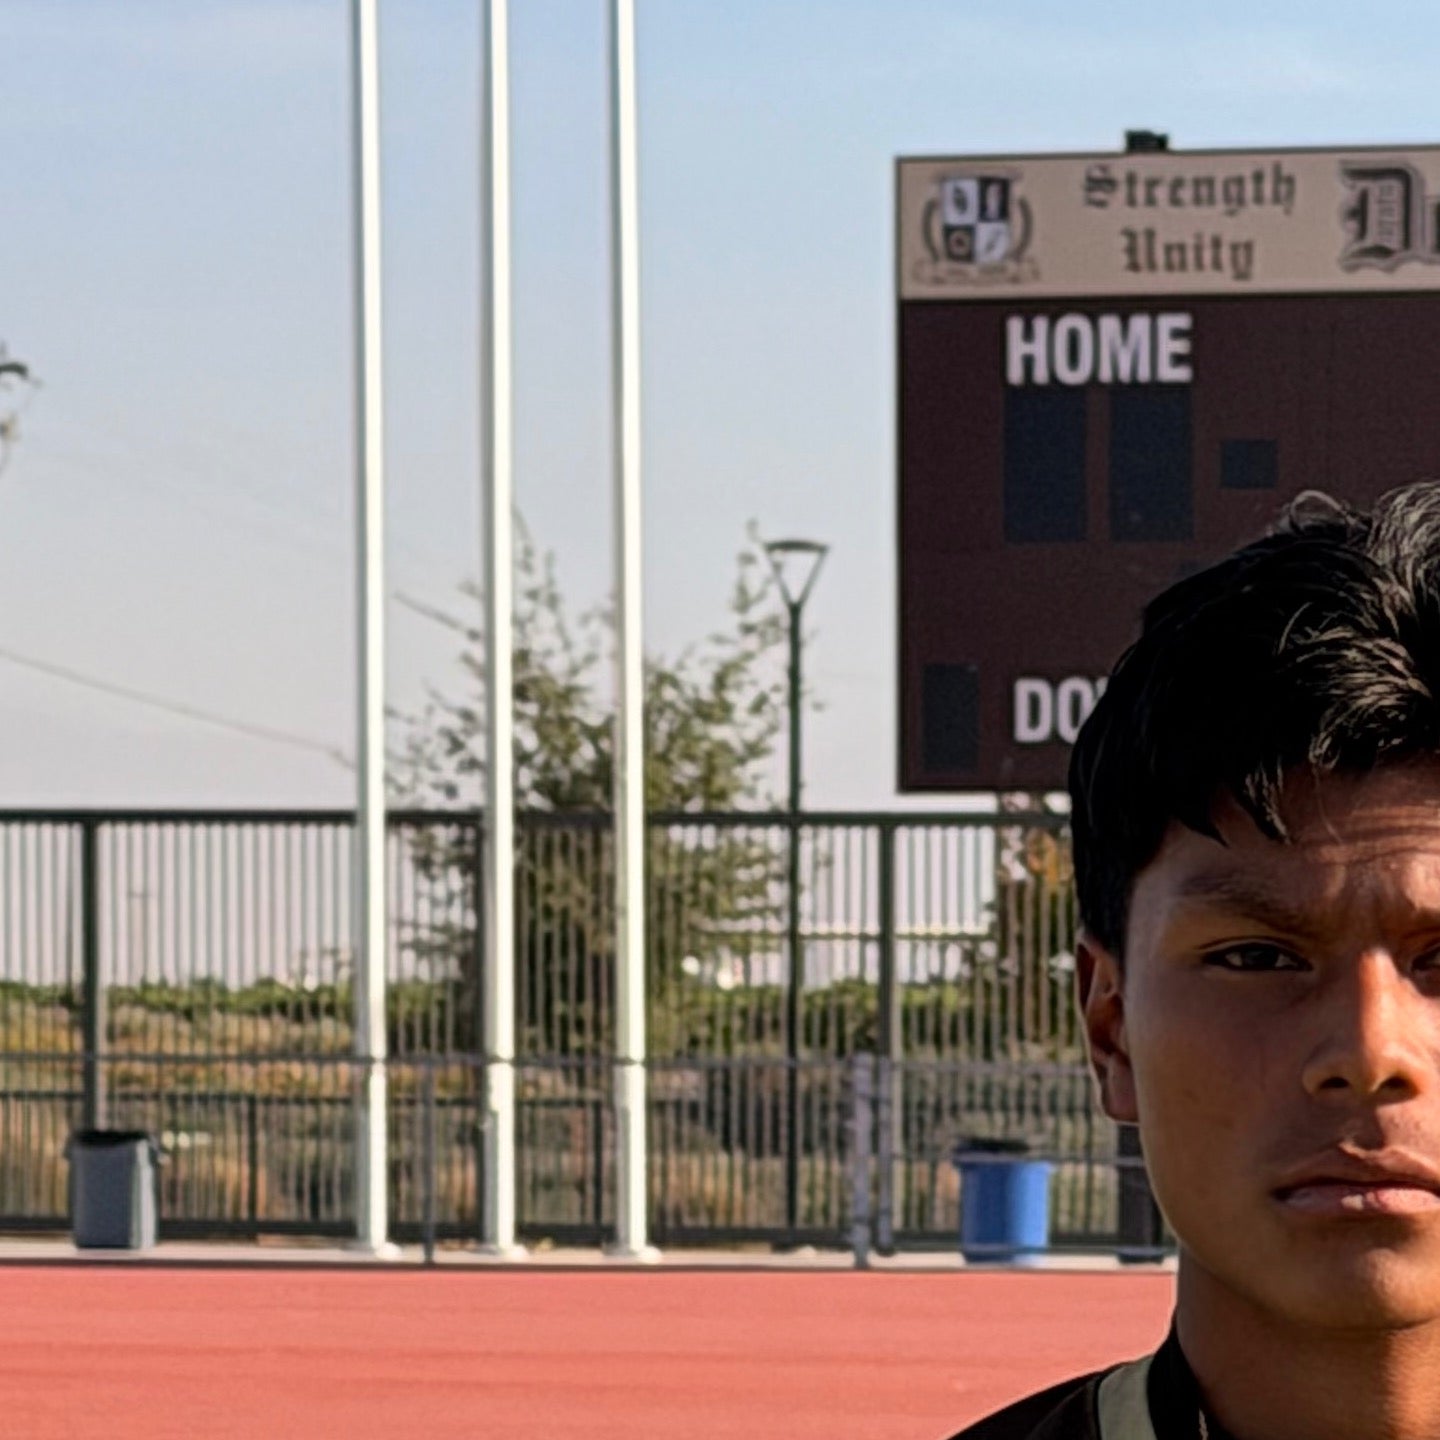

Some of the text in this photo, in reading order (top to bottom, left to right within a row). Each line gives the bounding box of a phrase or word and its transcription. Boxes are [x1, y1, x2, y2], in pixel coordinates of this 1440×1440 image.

[1084, 160, 1297, 217] Strength
[1121, 226, 1253, 282] Unity
[1006, 313, 1193, 385] HOME
[1013, 675, 1110, 745] DO
